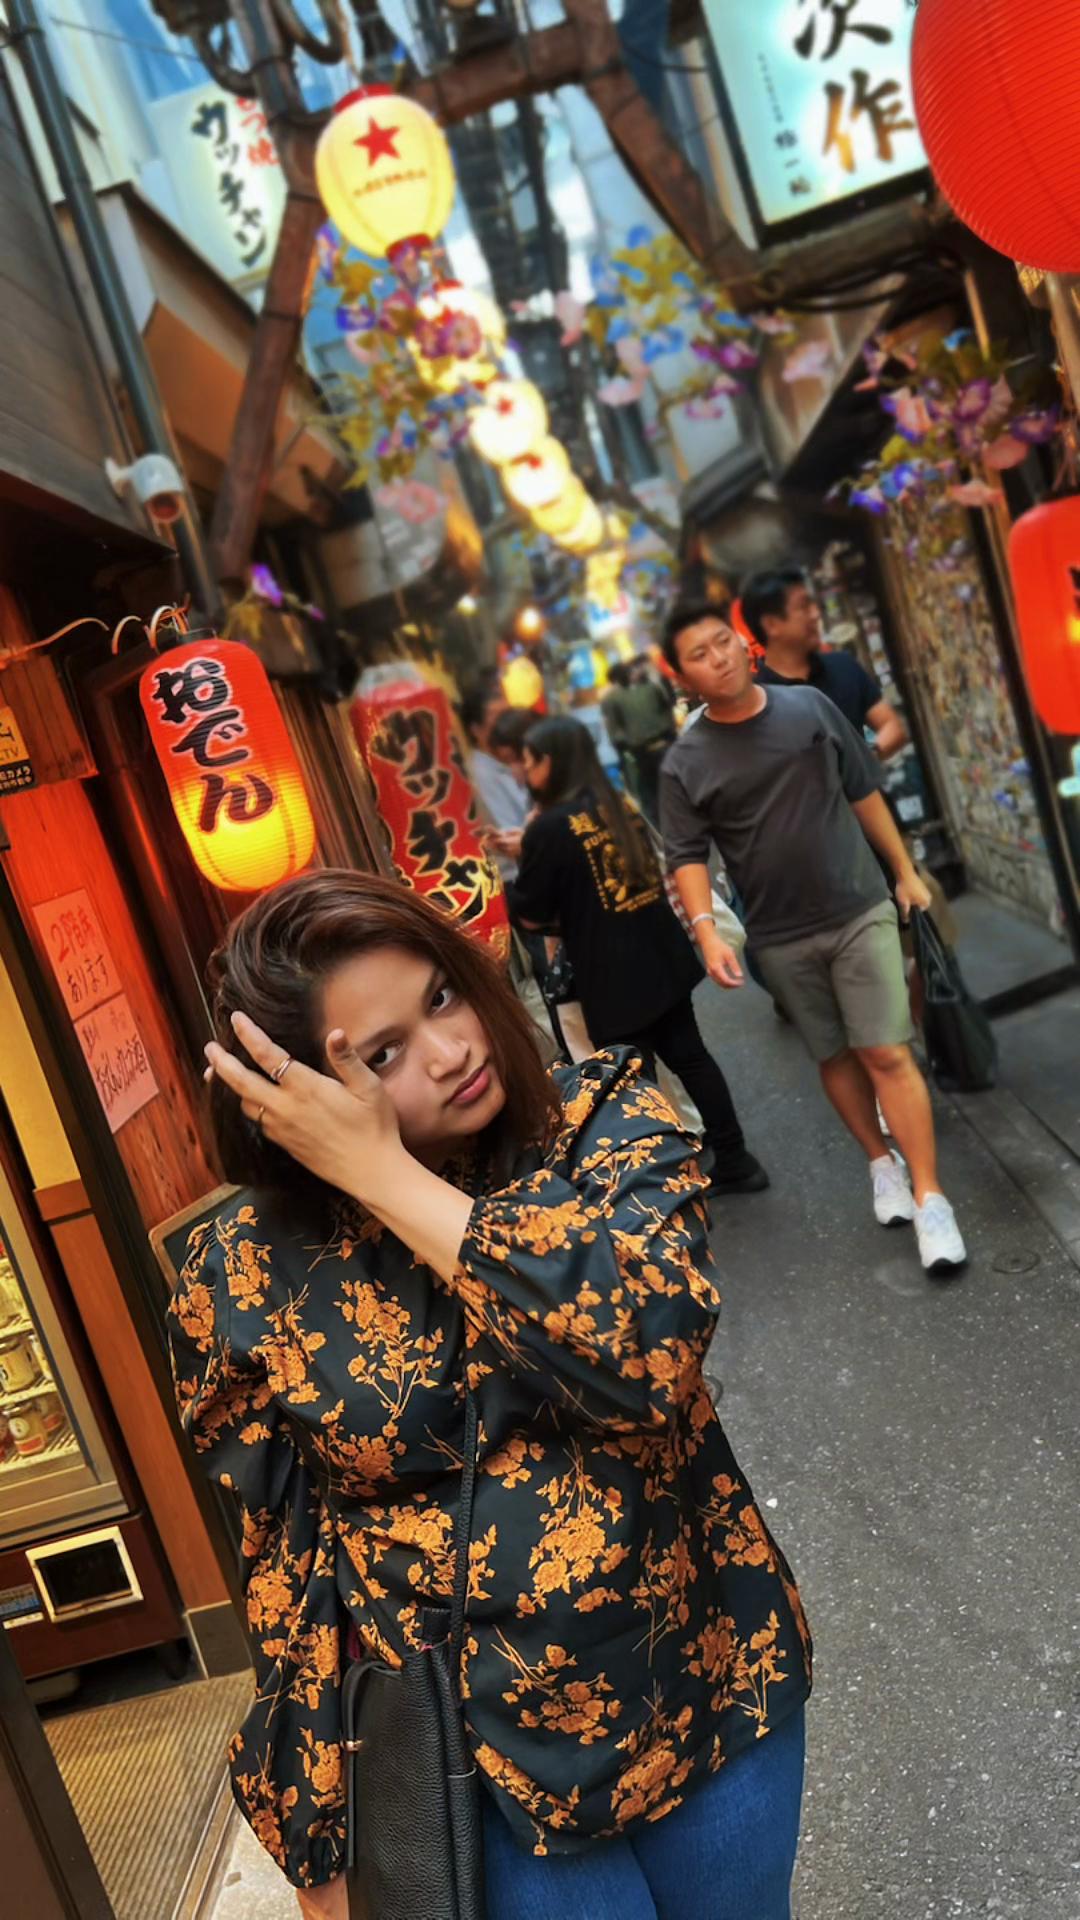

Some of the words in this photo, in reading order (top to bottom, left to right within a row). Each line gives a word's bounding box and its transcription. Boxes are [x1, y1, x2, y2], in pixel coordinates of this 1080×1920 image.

[152, 659, 273, 833] おでん
[67, 954, 109, 1004] あります
